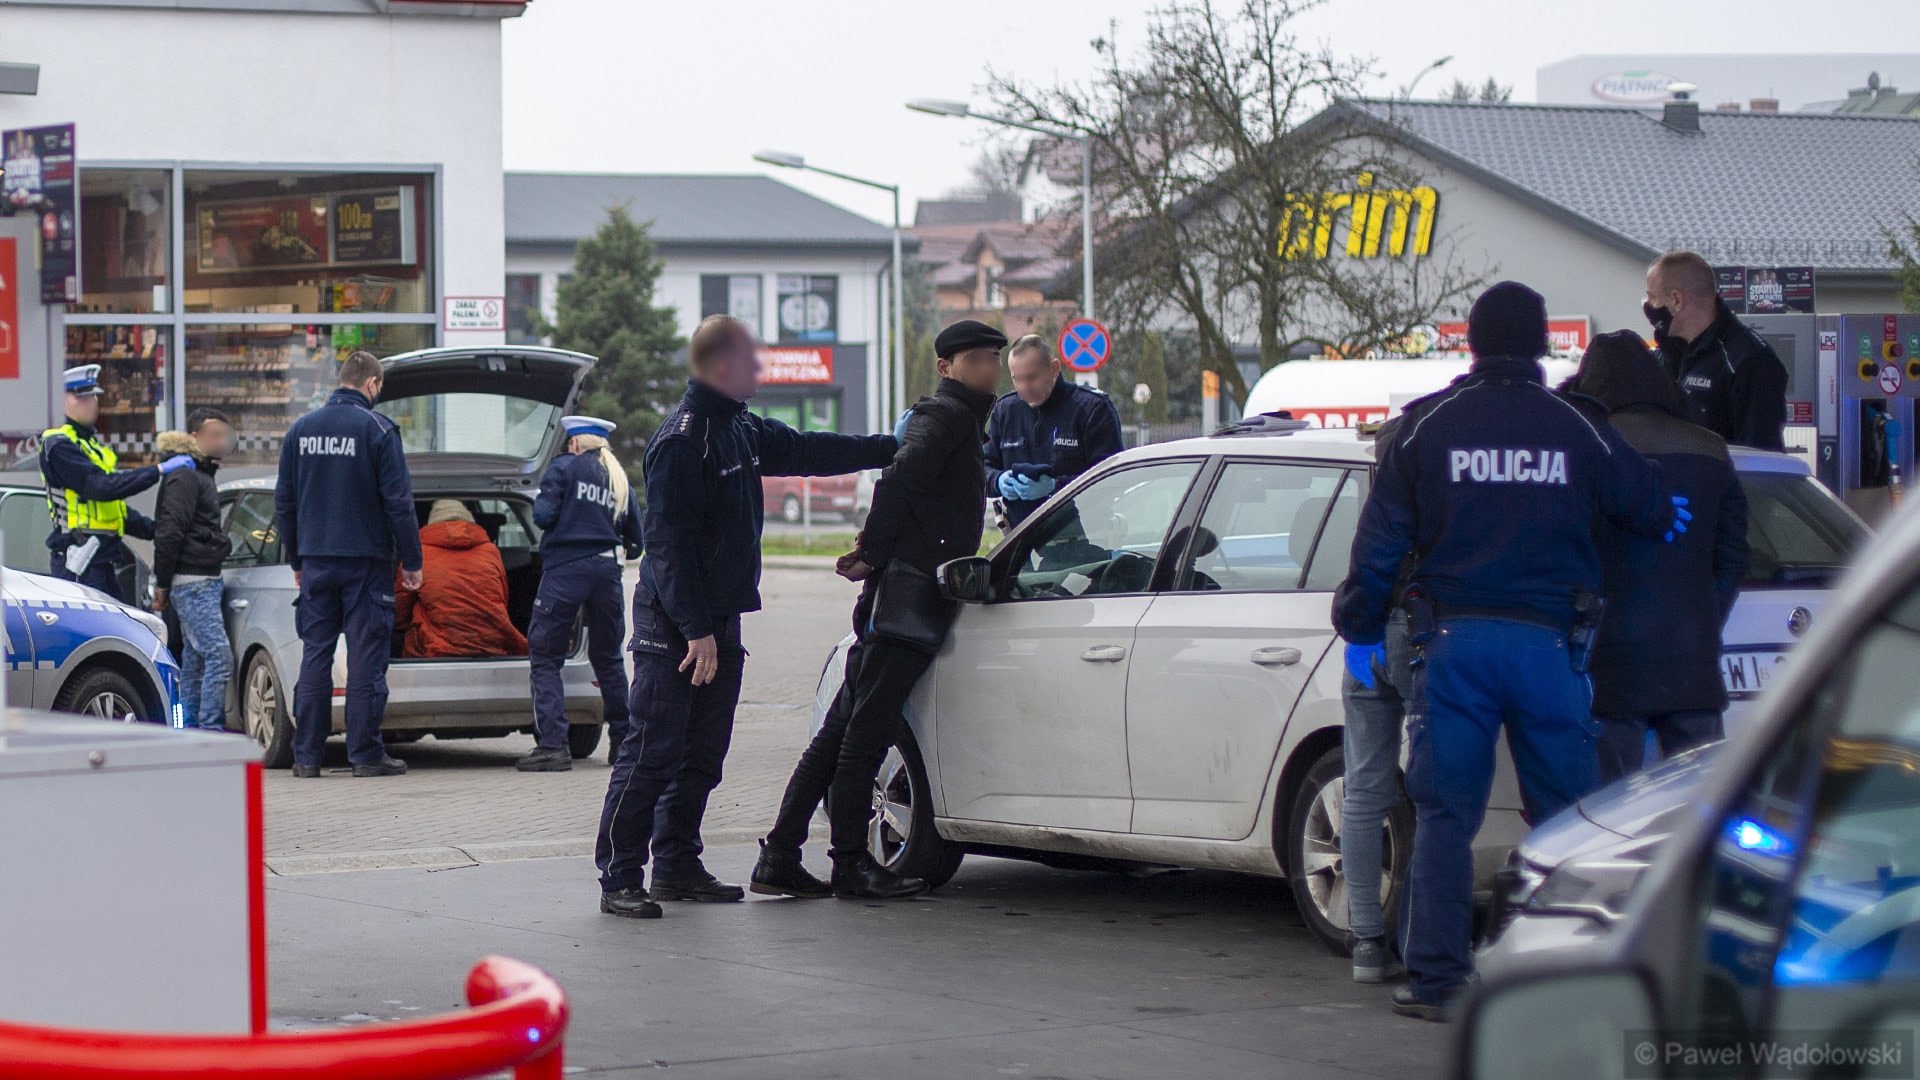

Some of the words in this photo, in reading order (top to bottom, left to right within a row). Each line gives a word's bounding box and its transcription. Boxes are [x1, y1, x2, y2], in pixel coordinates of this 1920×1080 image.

[1820, 335, 1835, 347] LPG
[299, 436, 356, 457] POLICJA
[1824, 445, 1832, 460] 9
[1451, 449, 1567, 484] POLICJA
[576, 481, 628, 514] POLIC
